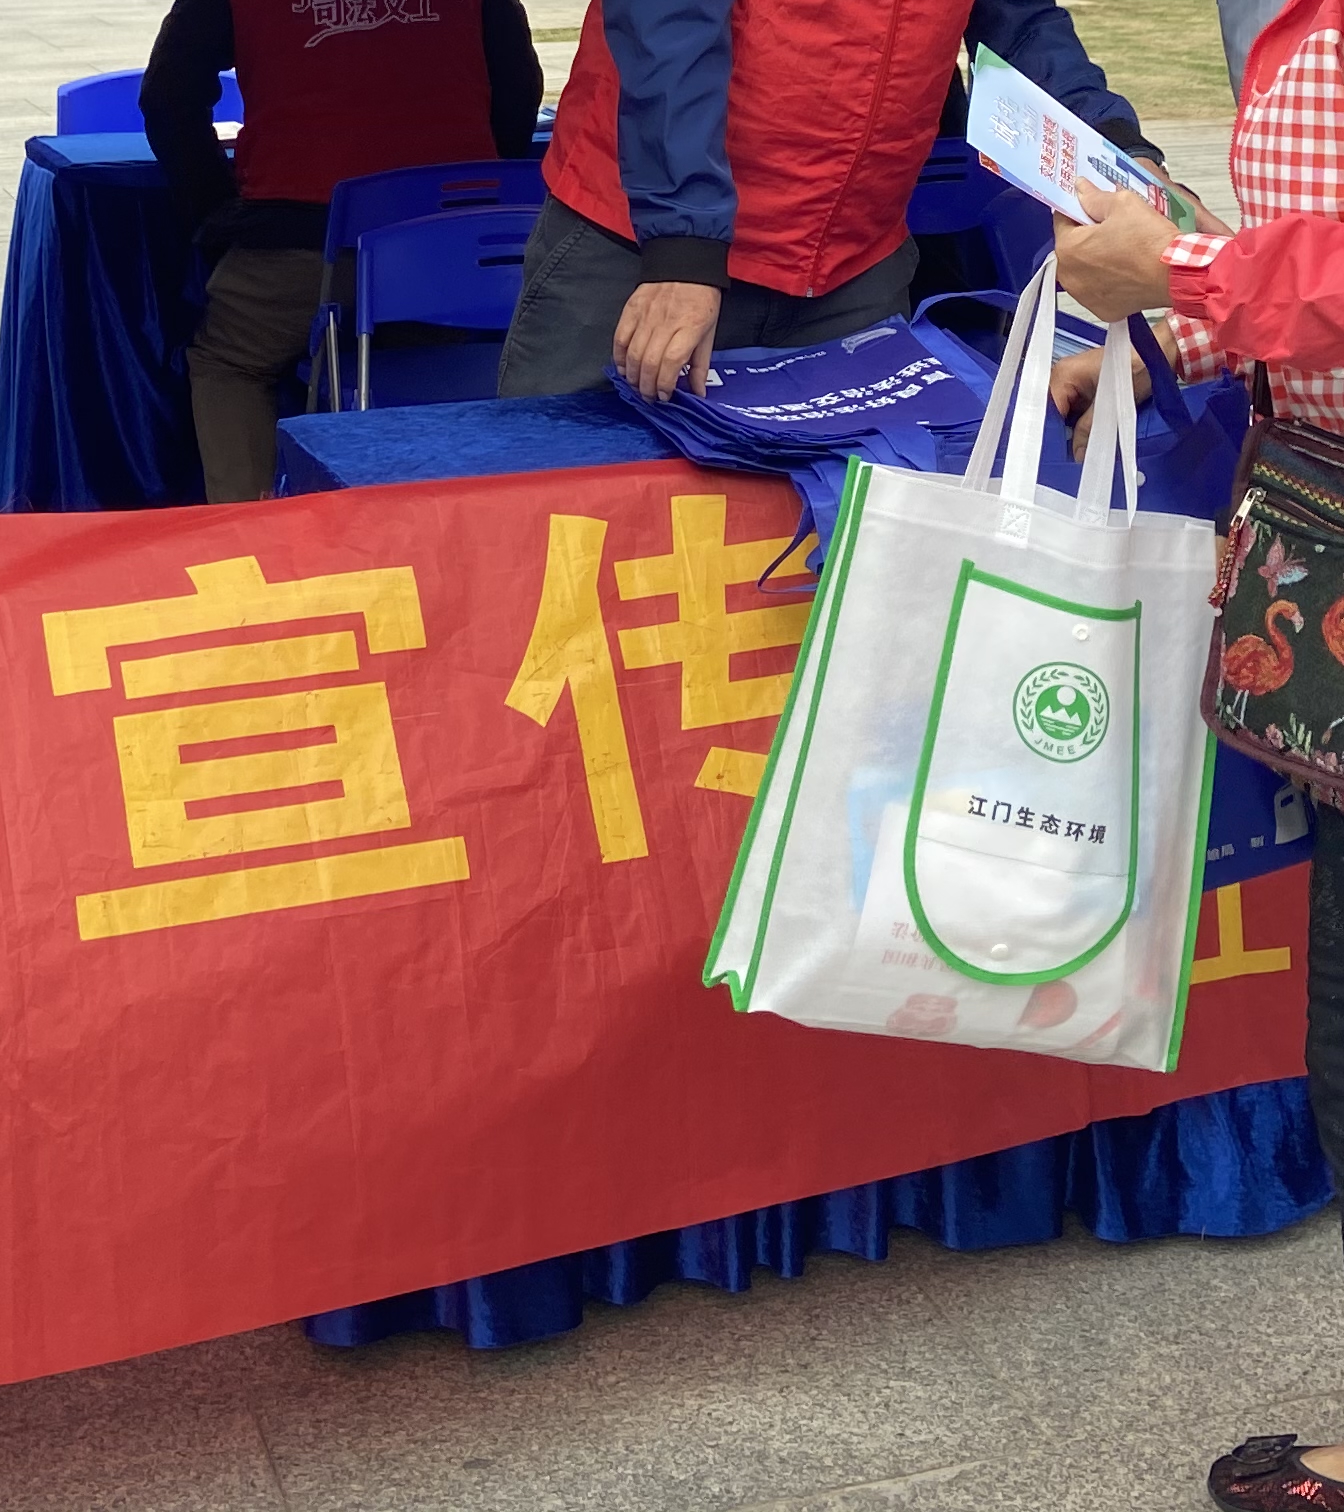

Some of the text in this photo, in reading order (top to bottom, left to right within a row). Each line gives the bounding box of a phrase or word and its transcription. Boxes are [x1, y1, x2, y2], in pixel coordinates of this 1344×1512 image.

[1033, 736, 1076, 757] JMEE
[968, 795, 1107, 844] 江门生态环境
